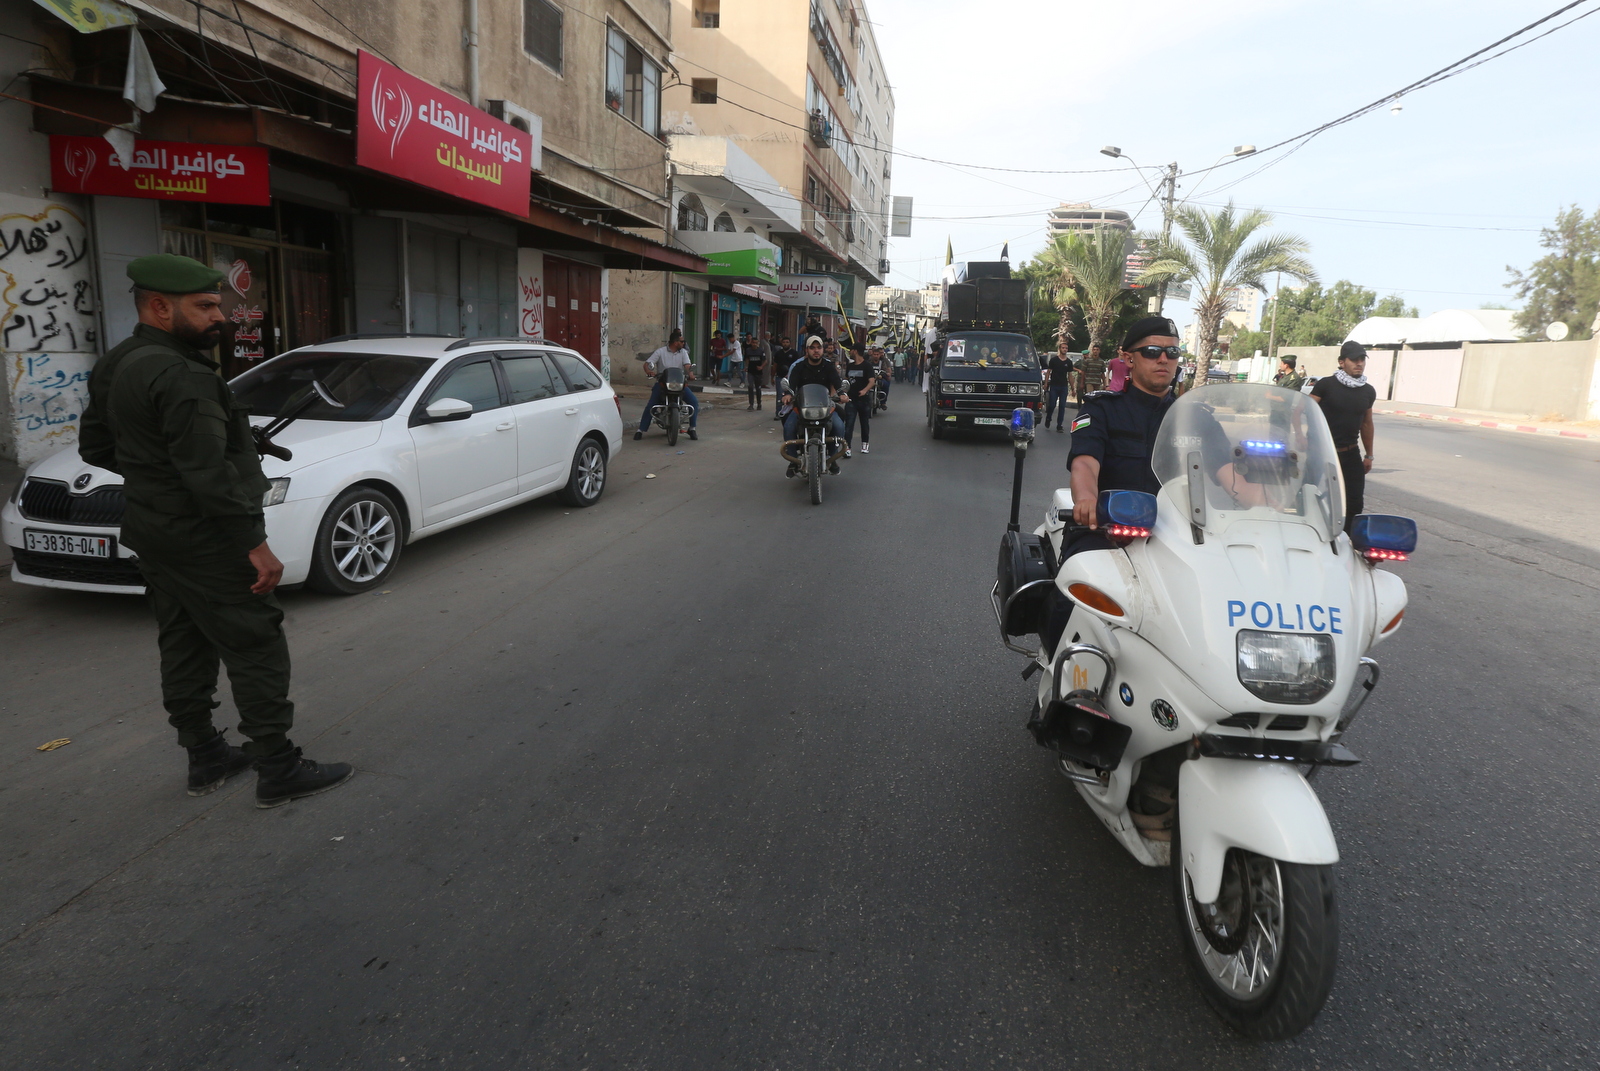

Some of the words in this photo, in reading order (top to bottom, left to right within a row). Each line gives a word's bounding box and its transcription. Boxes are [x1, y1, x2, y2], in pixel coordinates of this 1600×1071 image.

[418, 99, 470, 141] الهناء
[471, 127, 523, 163] كوافير
[171, 151, 245, 179] كوافير
[436, 142, 502, 185] للسيدات
[134, 174, 207, 195] للسيدات
[519, 276, 543, 302] شاورما
[777, 281, 824, 295] برادايس
[230, 304, 264, 323] كوافير
[235, 325, 262, 344] الهناء
[233, 345, 264, 361] للسيدات
[1172, 437, 1202, 447] POLICE
[28, 534, 94, 555] 3-3836-04
[1227, 600, 1343, 634] POLICE
